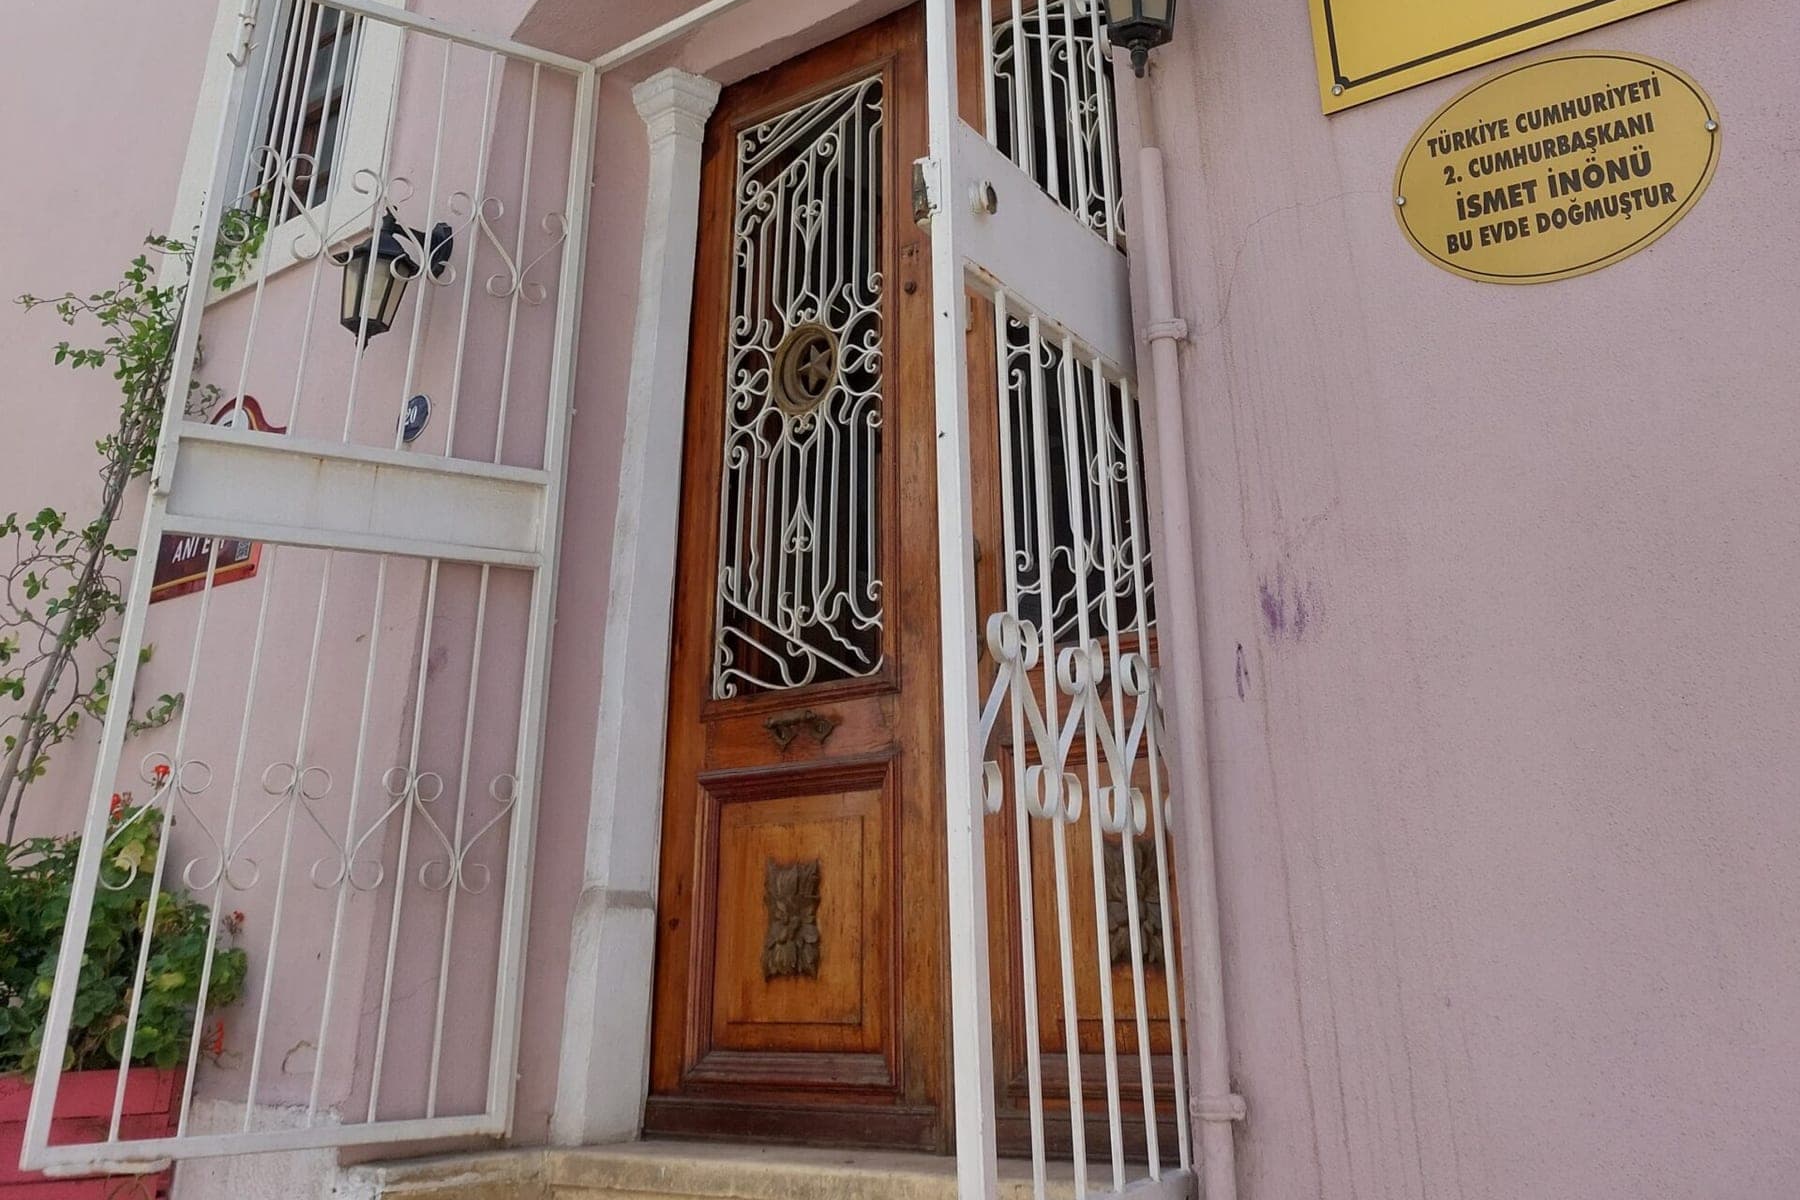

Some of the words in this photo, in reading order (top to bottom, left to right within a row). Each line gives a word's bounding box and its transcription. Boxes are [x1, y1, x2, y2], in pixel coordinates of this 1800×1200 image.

[1427, 118, 1510, 158] TÜRKİYE
[1515, 70, 1661, 133] CUMHURİYETİ
[1443, 165, 1463, 186] 2.
[1468, 111, 1655, 178] CUMHURBAŞKANI
[1446, 229, 1473, 255] BU
[1479, 216, 1531, 247] EVDE
[1535, 181, 1678, 234] DOĞMUŞTUR
[1455, 178, 1538, 221] İSMET
[1547, 144, 1652, 198] İNÖNÜ
